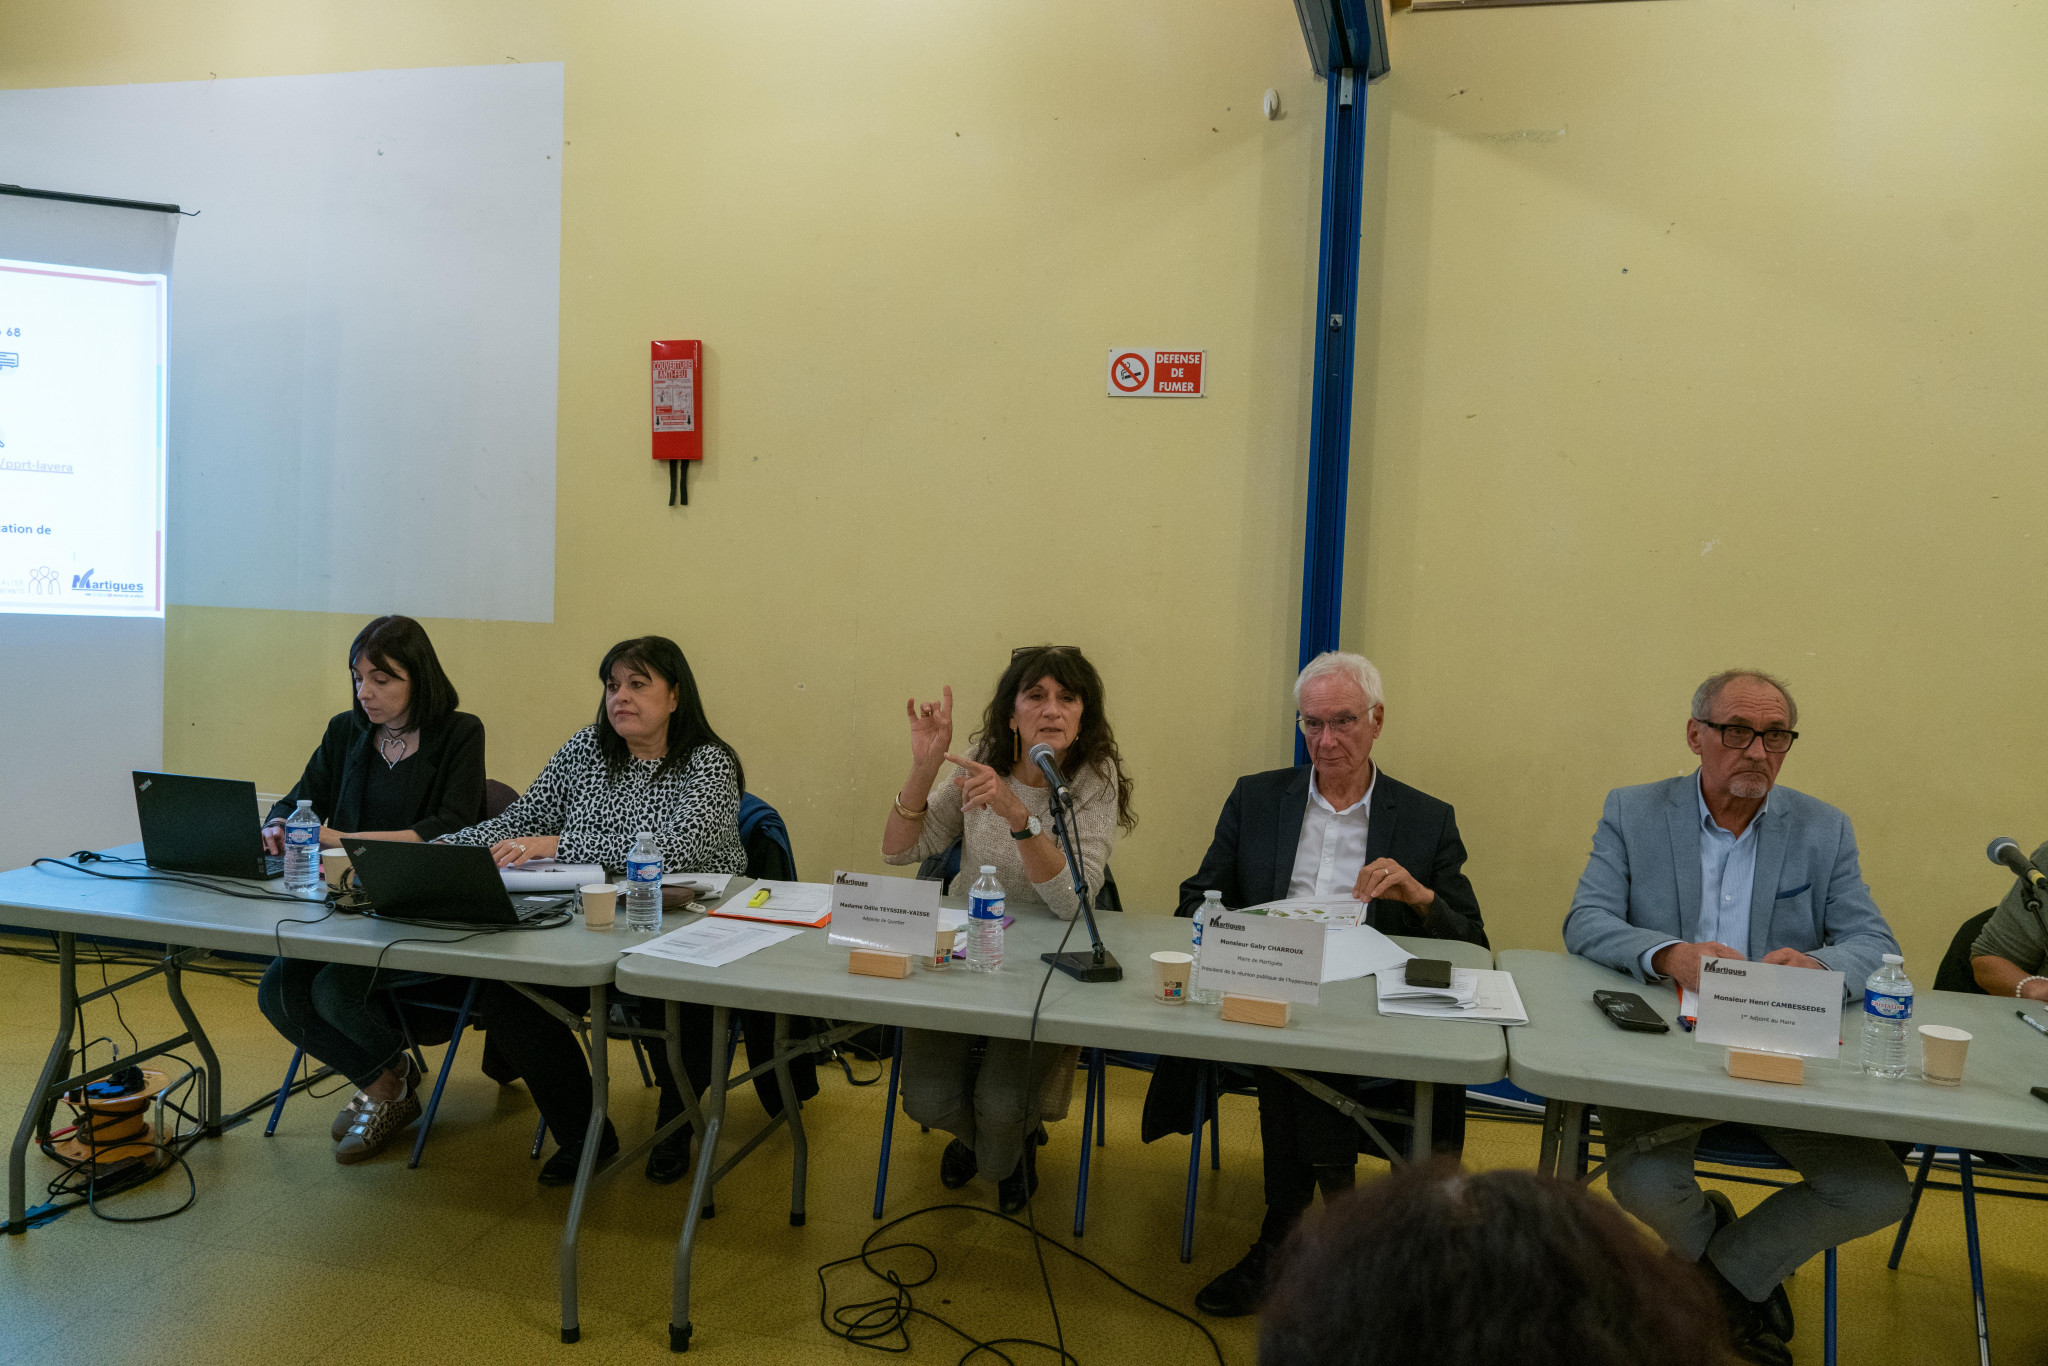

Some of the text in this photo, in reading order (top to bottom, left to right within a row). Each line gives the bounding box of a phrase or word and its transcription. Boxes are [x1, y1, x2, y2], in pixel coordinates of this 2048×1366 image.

[6, 327, 21, 337] 68
[1156, 354, 1200, 364] DEFENSE
[1171, 367, 1184, 378] DE
[1159, 381, 1194, 392] FUMER
[0, 523, 52, 535] ation de
[72, 568, 144, 592] Martigues
[836, 872, 868, 887] Martigues
[840, 902, 863, 910] Madame
[880, 906, 930, 917] TEYSSIER-VAISSE
[1209, 915, 1246, 931] Martigues
[1220, 939, 1304, 955] Monsieur Gaby CHARROUX
[1237, 955, 1251, 963] Maire
[1259, 958, 1283, 967] Martigues
[1704, 959, 1747, 976] Martigues
[1201, 965, 1223, 974] Président
[1256, 973, 1277, 981] publique
[1714, 994, 1826, 1013] Monsieur Henri CAMBESSEDES
